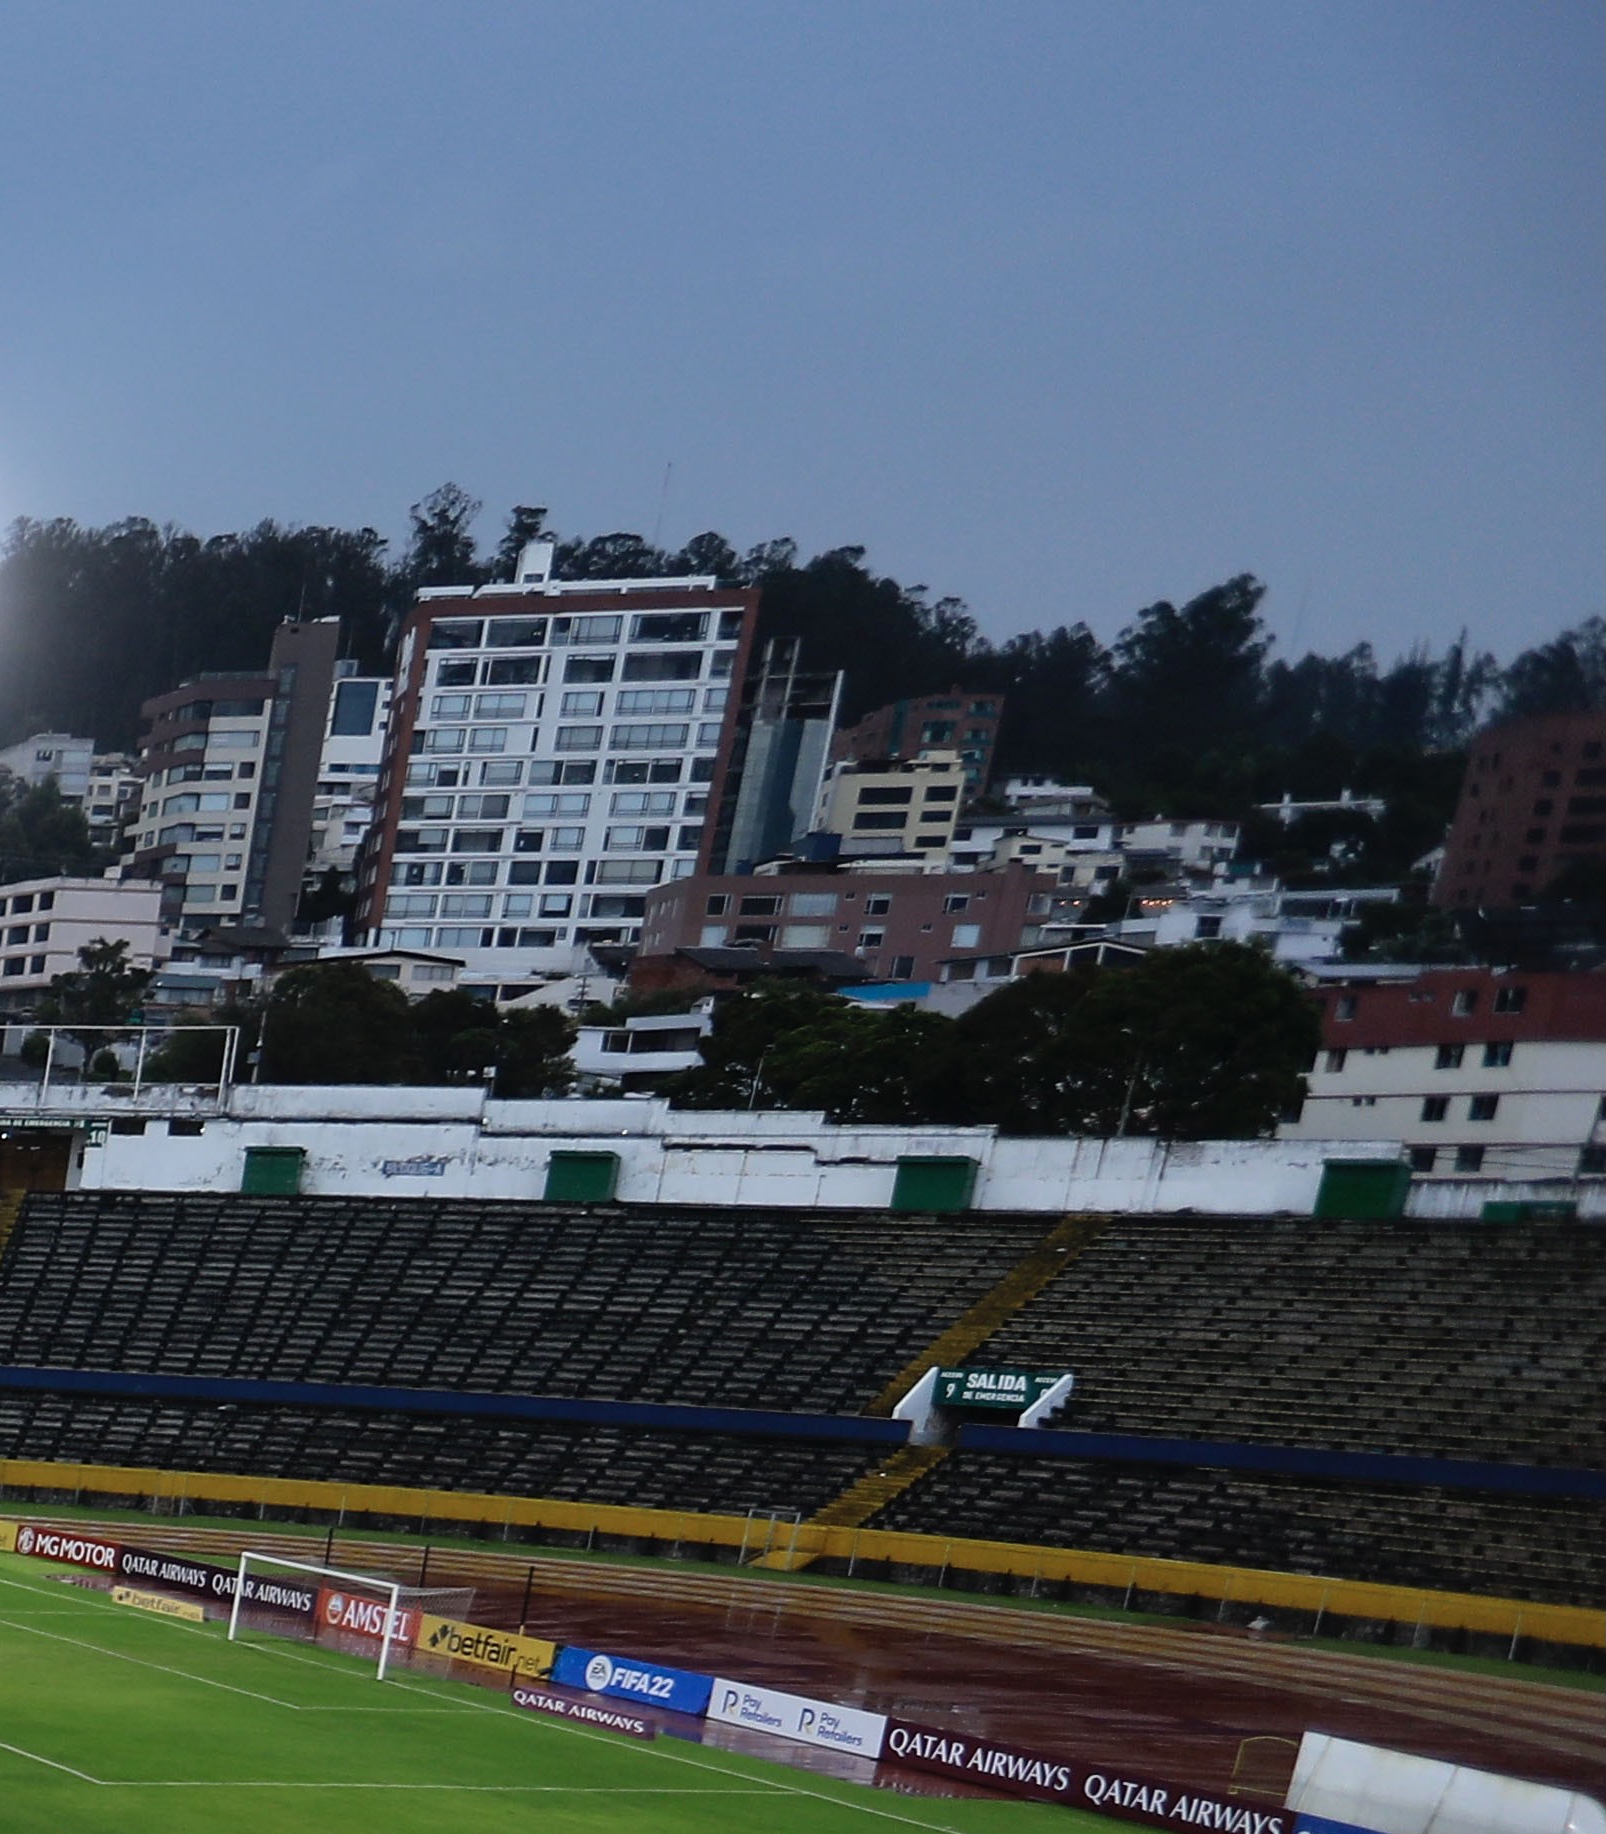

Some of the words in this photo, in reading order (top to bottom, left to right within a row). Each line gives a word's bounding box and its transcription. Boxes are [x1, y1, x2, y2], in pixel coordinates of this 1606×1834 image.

[945, 1382, 956, 1398] 9
[966, 1373, 1026, 1391] SALIDA
[34, 1533, 59, 1557] MG
[59, 1537, 115, 1568] MOTOR
[121, 1552, 157, 1577] QATAR
[159, 1560, 207, 1588] AIRWAYS
[254, 1583, 312, 1612] AIRWAYS
[513, 1689, 566, 1714] QATAR
[569, 1704, 645, 1734] AIRWAYS
[742, 1693, 762, 1712] Pay
[740, 1705, 783, 1728] Retailers
[818, 1711, 841, 1731] Pay
[817, 1724, 863, 1747] Retailers
[889, 1727, 964, 1766] QATAR
[967, 1747, 1070, 1791] AIRWAYS
[1084, 1774, 1167, 1816] QATAR
